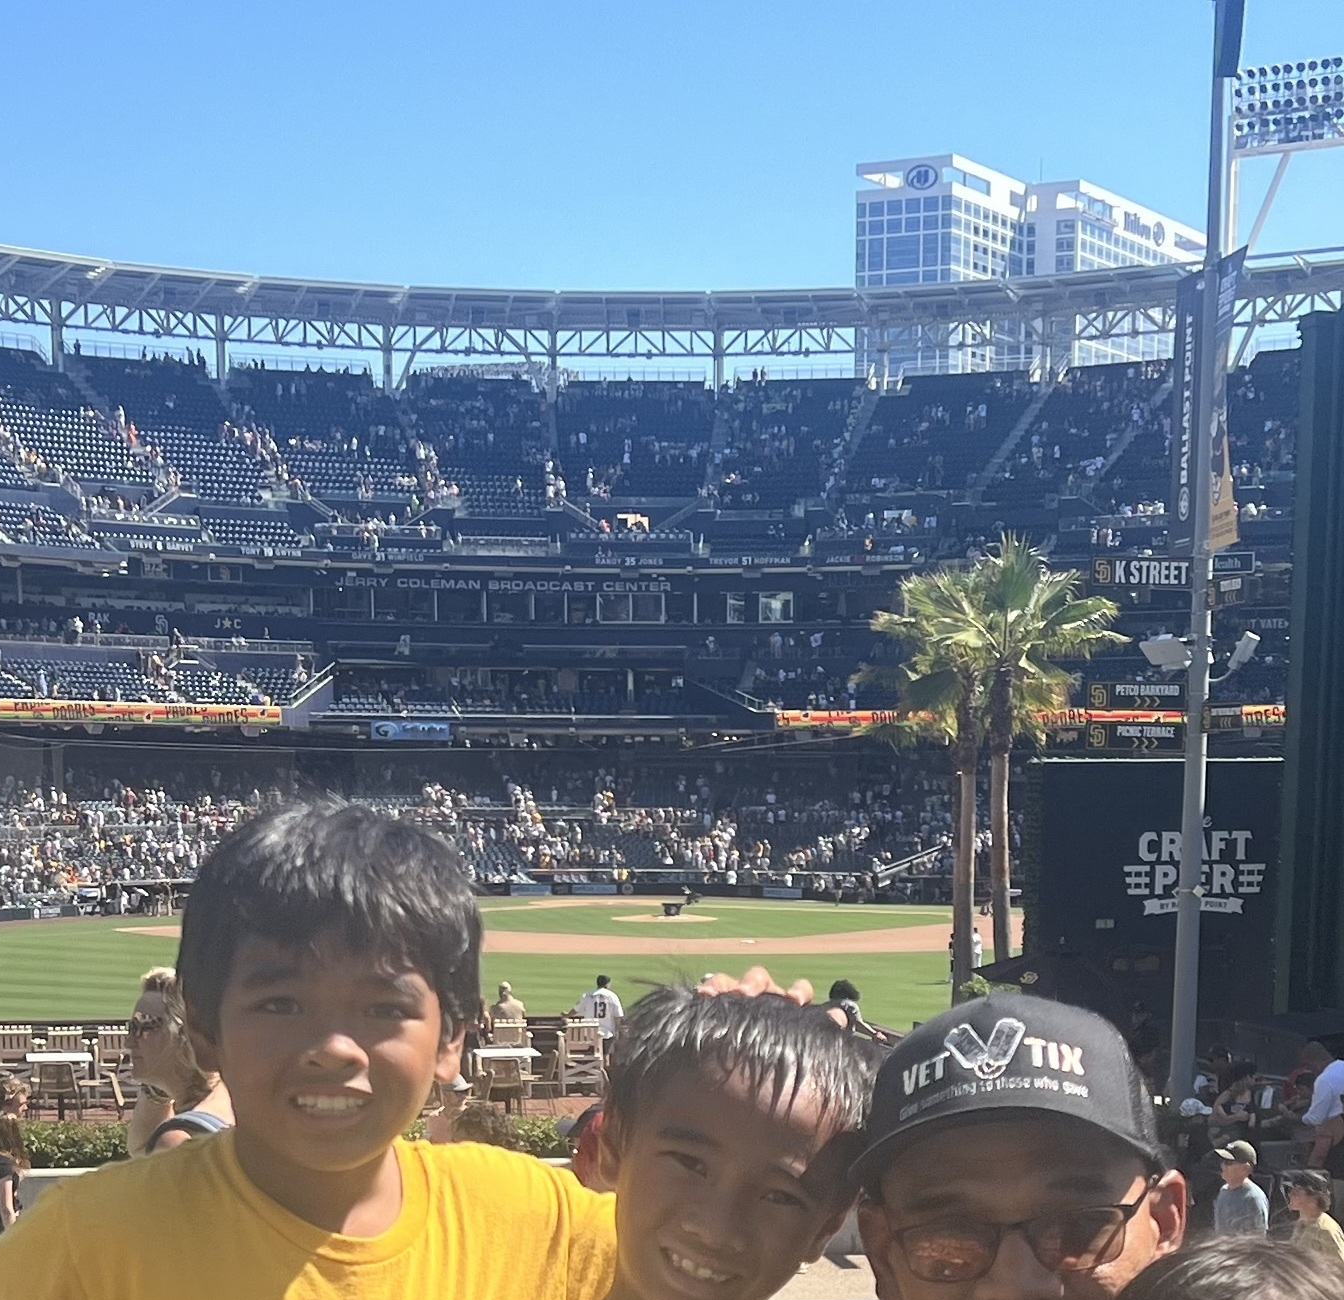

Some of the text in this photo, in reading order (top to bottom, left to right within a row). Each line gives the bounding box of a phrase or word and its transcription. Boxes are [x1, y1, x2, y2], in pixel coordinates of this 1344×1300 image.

[1179, 313, 1194, 484] BALLAST POINT
[624, 557, 636, 566] 35
[638, 557, 664, 566] JONES
[709, 557, 739, 565] TREVOR
[754, 556, 791, 564] HOFFMAN
[826, 555, 851, 564] JACKIE
[865, 554, 905, 563] ROBINSON
[1114, 560, 1128, 584] K
[1130, 561, 1190, 585] STREET
[335, 577, 672, 592] JERRY COLEMAN BROADCAST CENTER
[88, 612, 110, 624] RAK
[1115, 684, 1139, 696] PETCO
[1140, 685, 1180, 697] BARKYARD
[1116, 726, 1141, 737] PICNIC
[1142, 726, 1176, 738] TERRACE
[902, 1036, 1085, 1096] VET TIX
[995, 1075, 1031, 1090] those
[1033, 1075, 1059, 1092] who
[1062, 1080, 1089, 1098] gave
